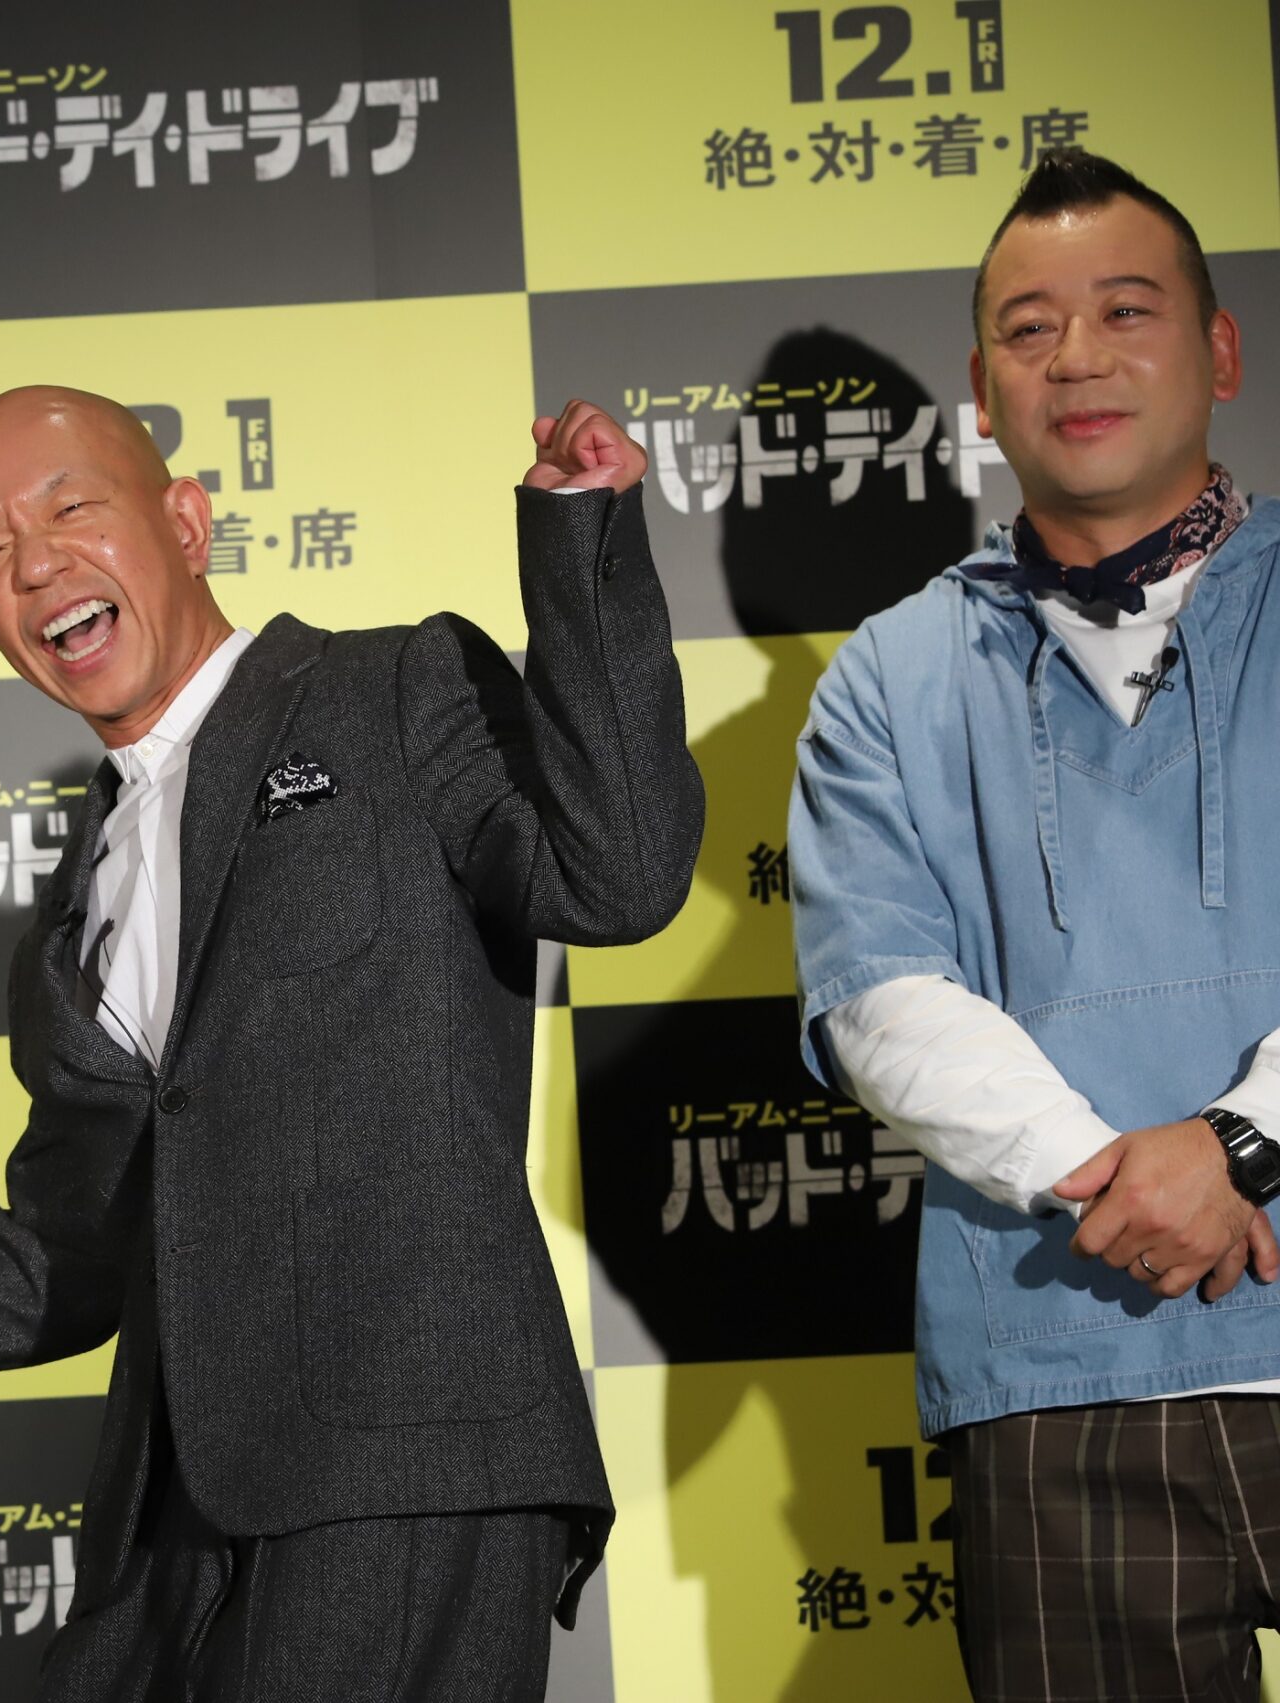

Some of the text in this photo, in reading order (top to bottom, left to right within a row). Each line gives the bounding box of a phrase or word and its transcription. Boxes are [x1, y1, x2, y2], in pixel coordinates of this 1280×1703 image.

[775, 0, 1005, 104] 12.1
[977, 19, 998, 84] FRI
[625, 377, 877, 417] リーアム・ニーソン
[247, 418, 269, 484] FRI
